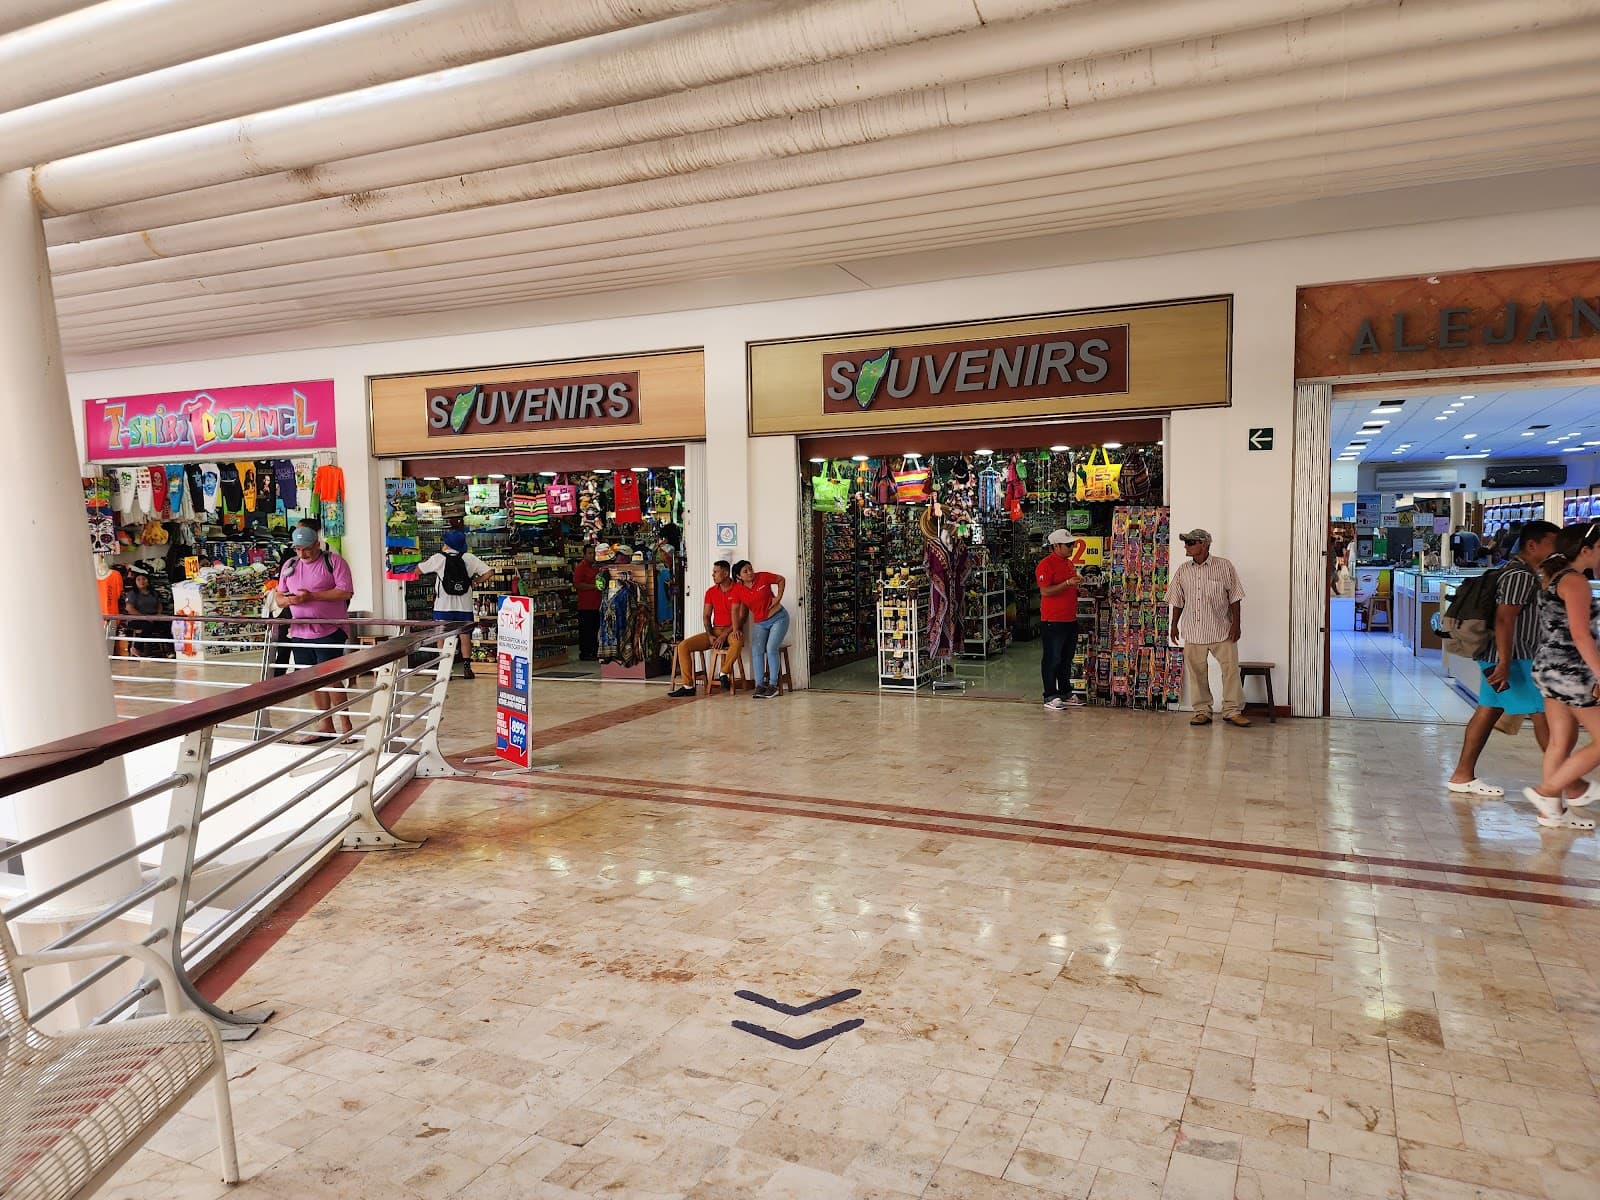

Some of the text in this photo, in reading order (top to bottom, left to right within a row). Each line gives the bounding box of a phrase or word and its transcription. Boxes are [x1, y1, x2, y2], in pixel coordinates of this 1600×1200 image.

[1350, 295, 1600, 356] ALEJAN
[1071, 538, 1099, 564] 2 USD
